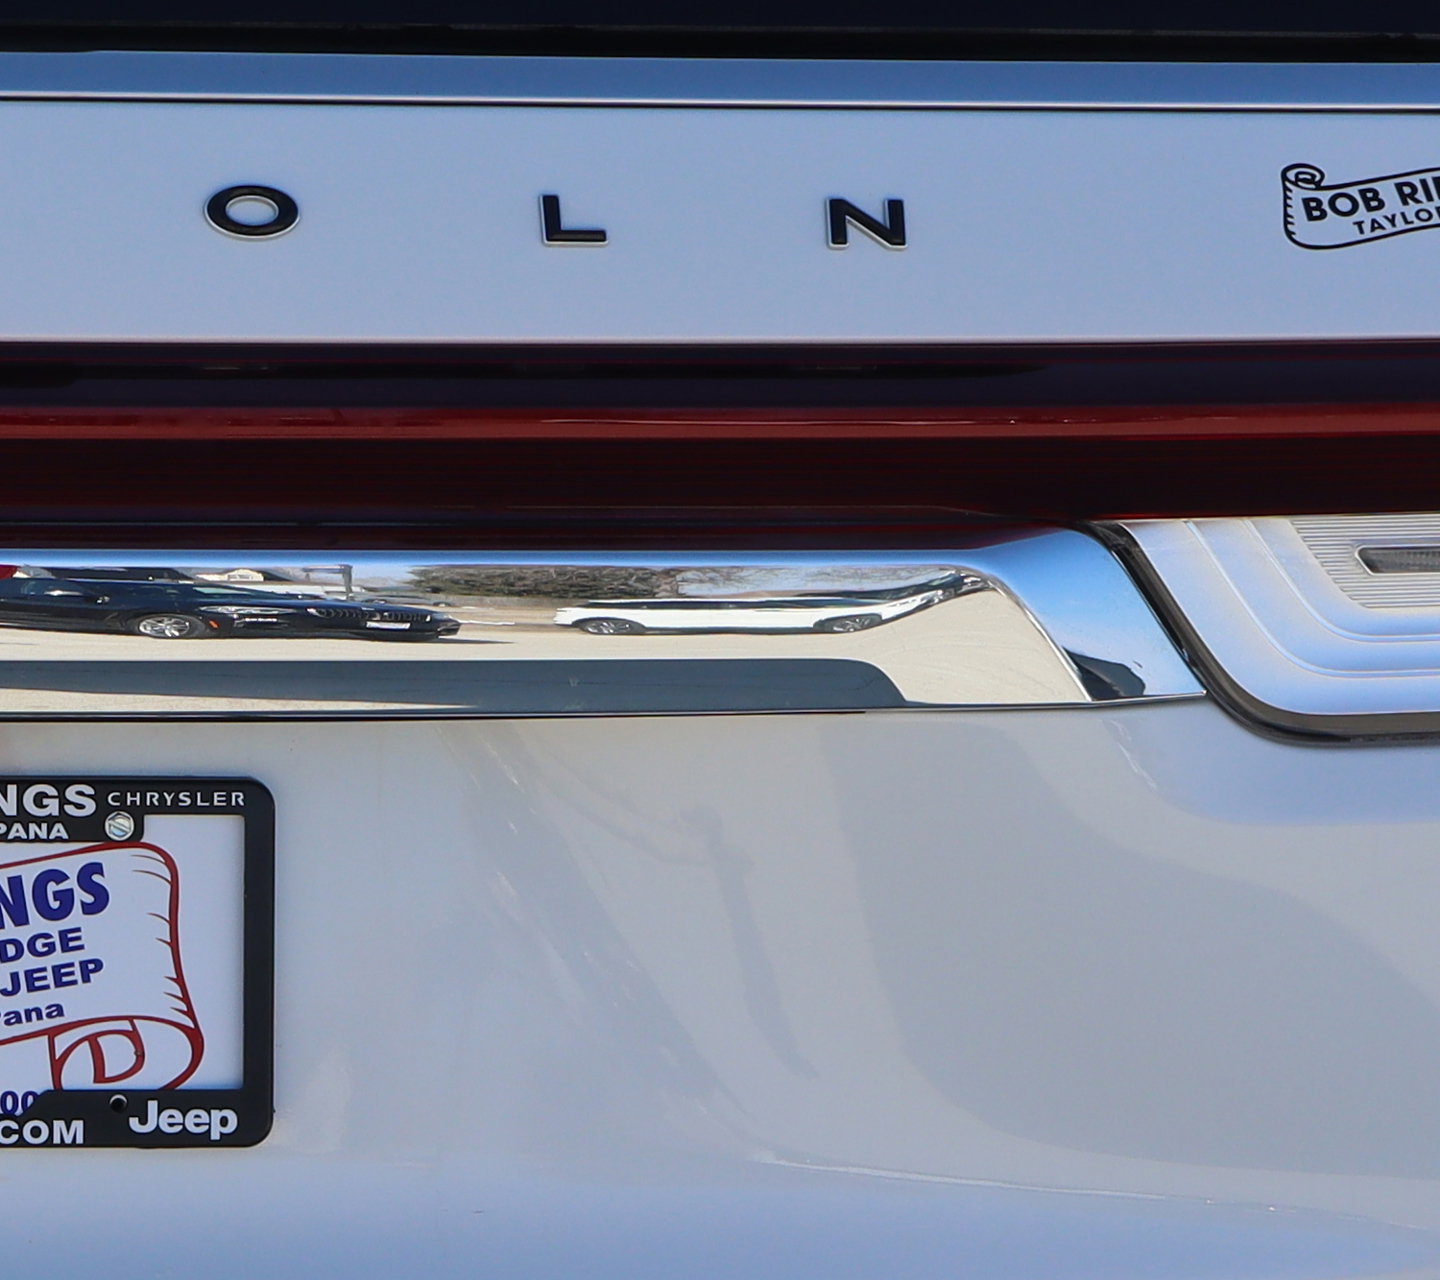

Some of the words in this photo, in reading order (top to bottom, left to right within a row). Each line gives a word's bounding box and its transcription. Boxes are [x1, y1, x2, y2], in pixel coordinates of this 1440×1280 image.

[1302, 187, 1386, 222] BOB
[107, 790, 246, 808] CHRYSLER
[0, 958, 105, 999] JEEP
[129, 1100, 238, 1140] Jeep
